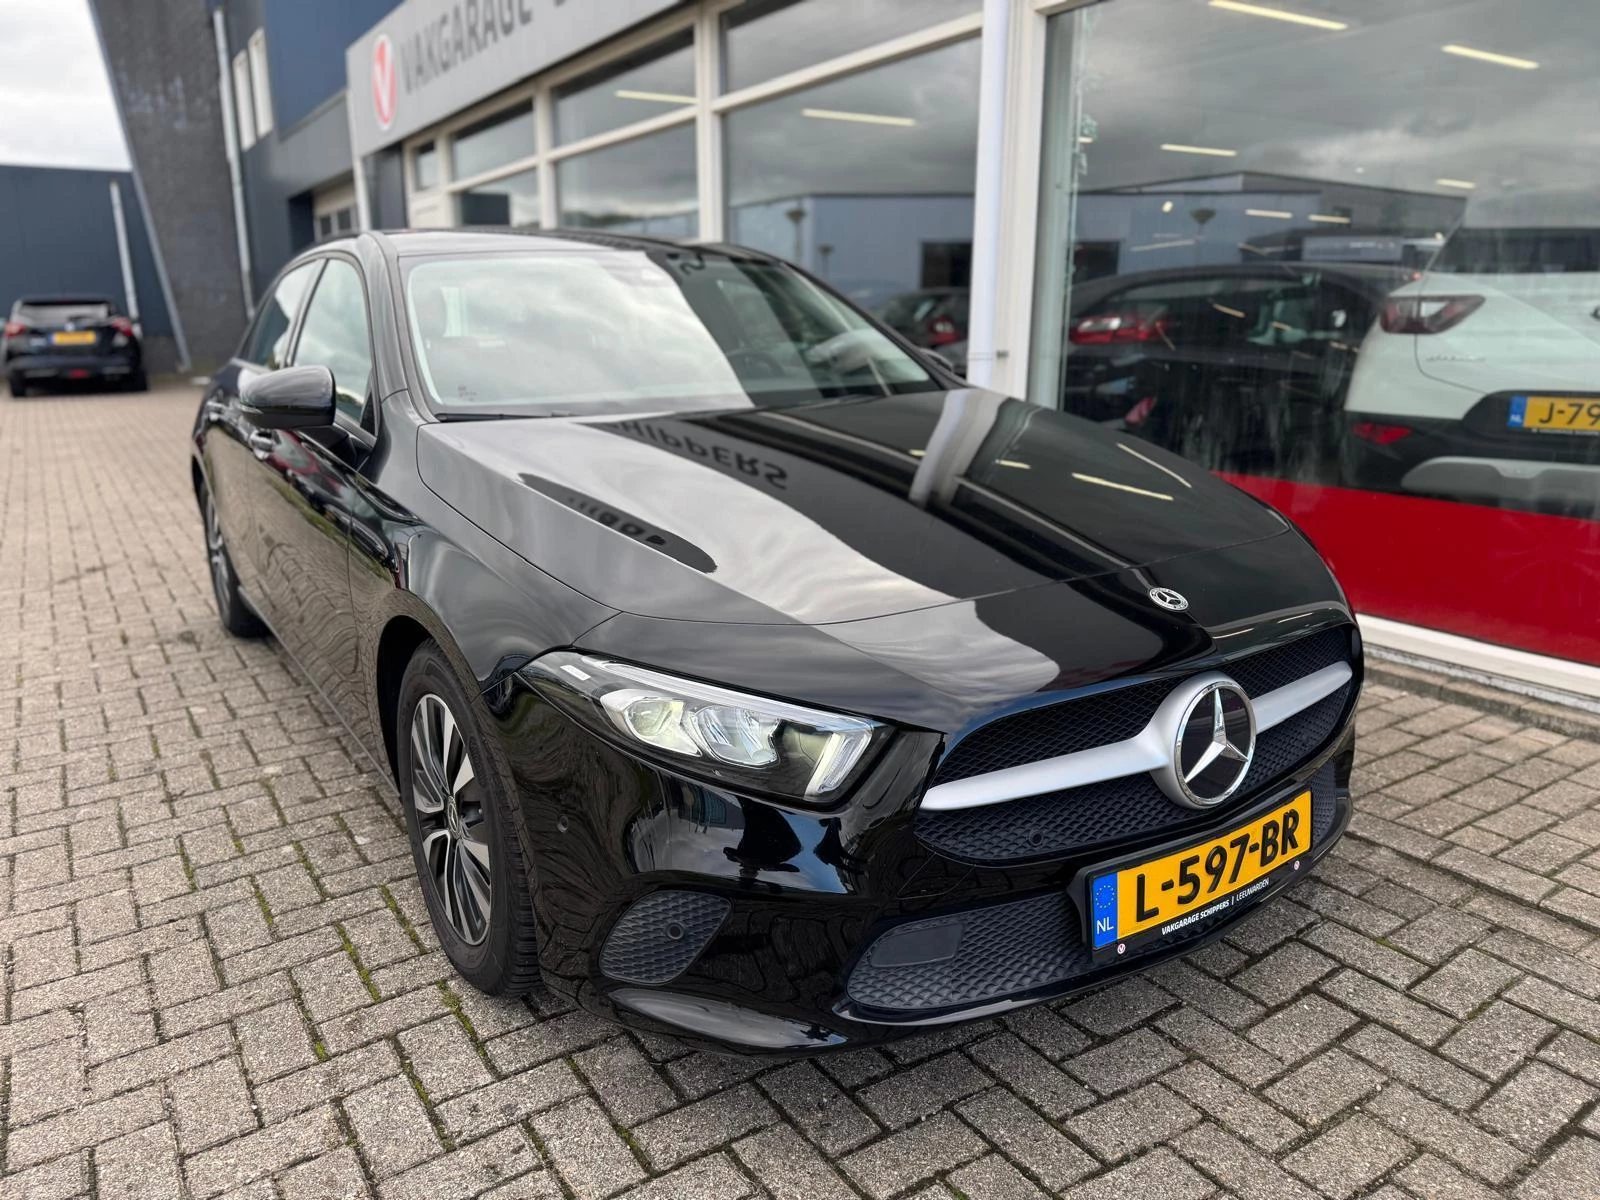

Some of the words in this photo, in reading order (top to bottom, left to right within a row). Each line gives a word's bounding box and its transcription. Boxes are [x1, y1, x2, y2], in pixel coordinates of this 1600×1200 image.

[1136, 809, 1300, 922] L-597-BR
[1096, 916, 1114, 935] NL
[1161, 912, 1200, 936] VAKGARAGE
[1200, 899, 1230, 919] SCHIPPERS
[1236, 877, 1270, 902] LEEUWARDEN
